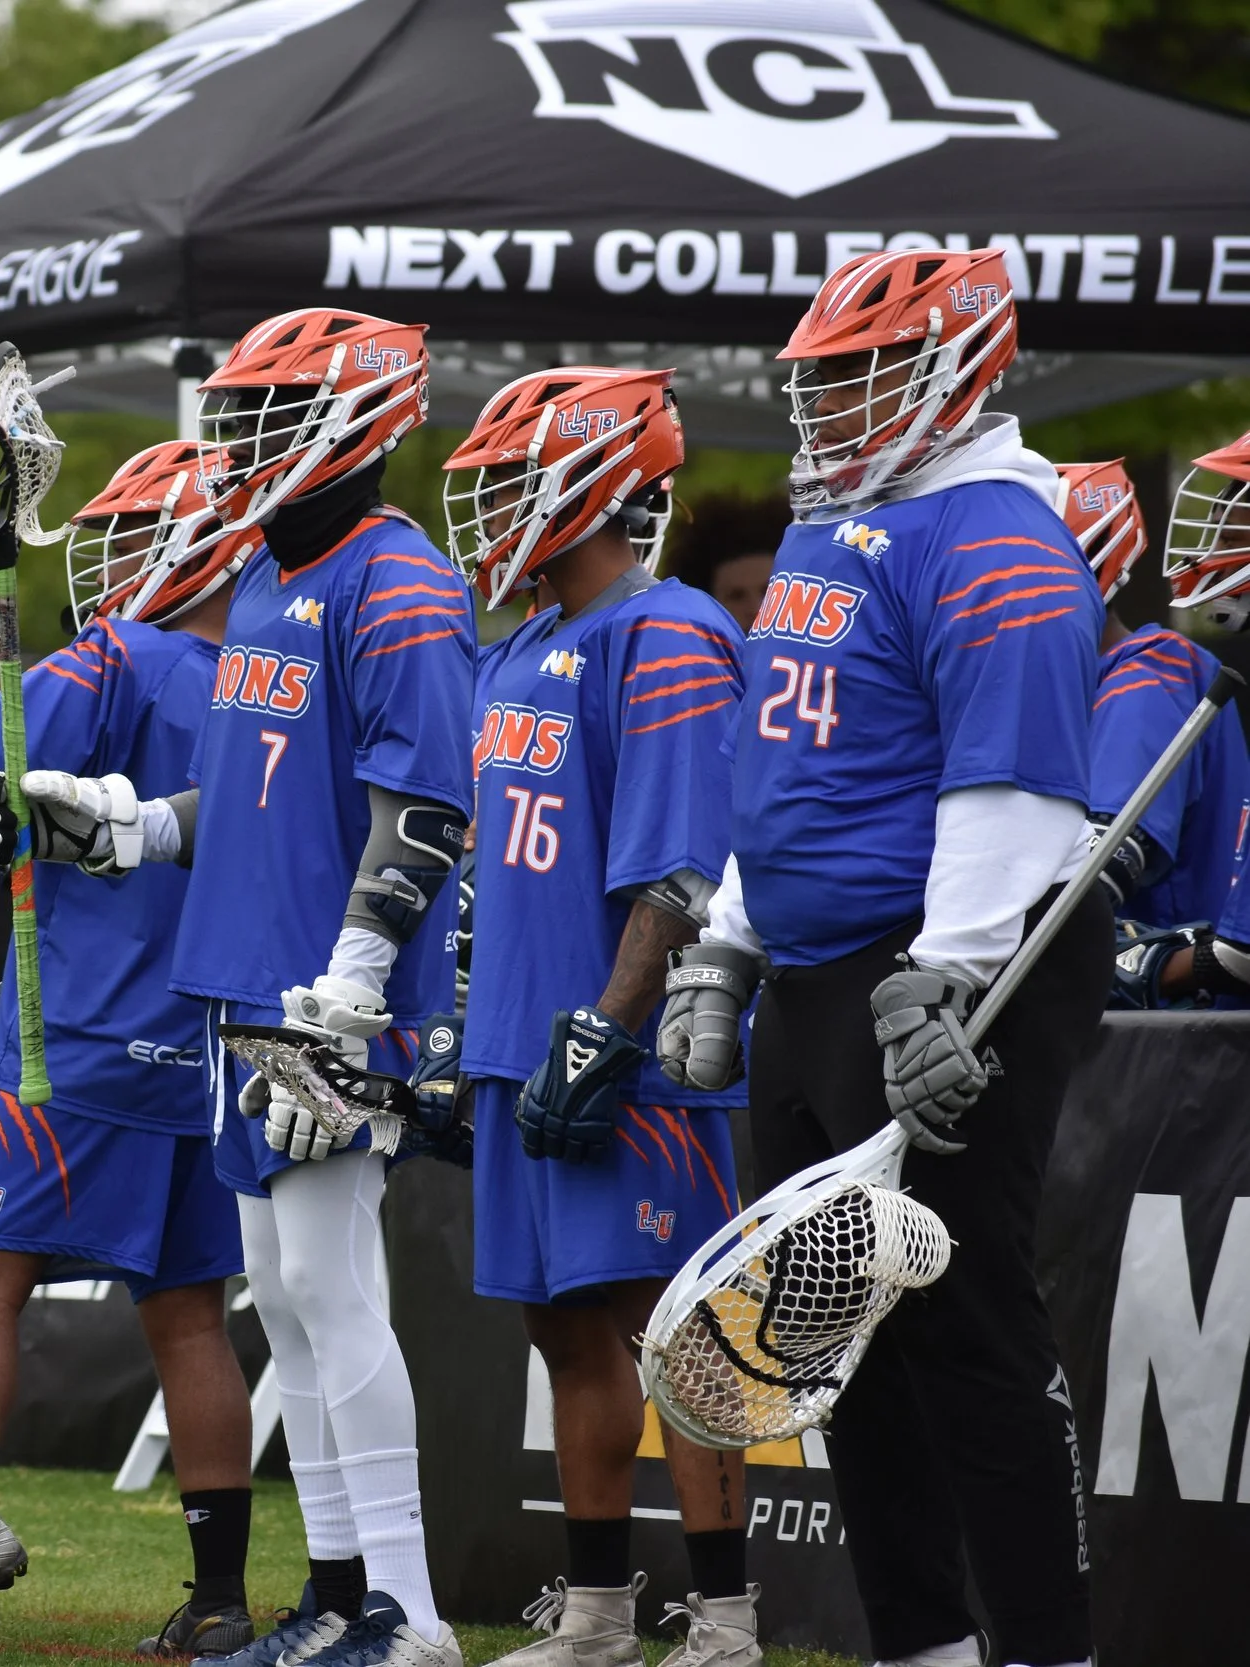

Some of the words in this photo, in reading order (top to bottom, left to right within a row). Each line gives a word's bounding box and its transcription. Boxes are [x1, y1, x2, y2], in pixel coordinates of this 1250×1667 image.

[540, 36, 1041, 126] NCL
[324, 226, 572, 291] NEXT
[595, 229, 1140, 303] COLLEATE
[478, 702, 573, 776] ONS
[758, 656, 839, 748] 24
[257, 730, 288, 808] 7
[503, 785, 563, 873] 16
[636, 1199, 677, 1245] LU
[746, 1497, 846, 1546] POR
[1065, 1418, 1091, 1573] Reebok
